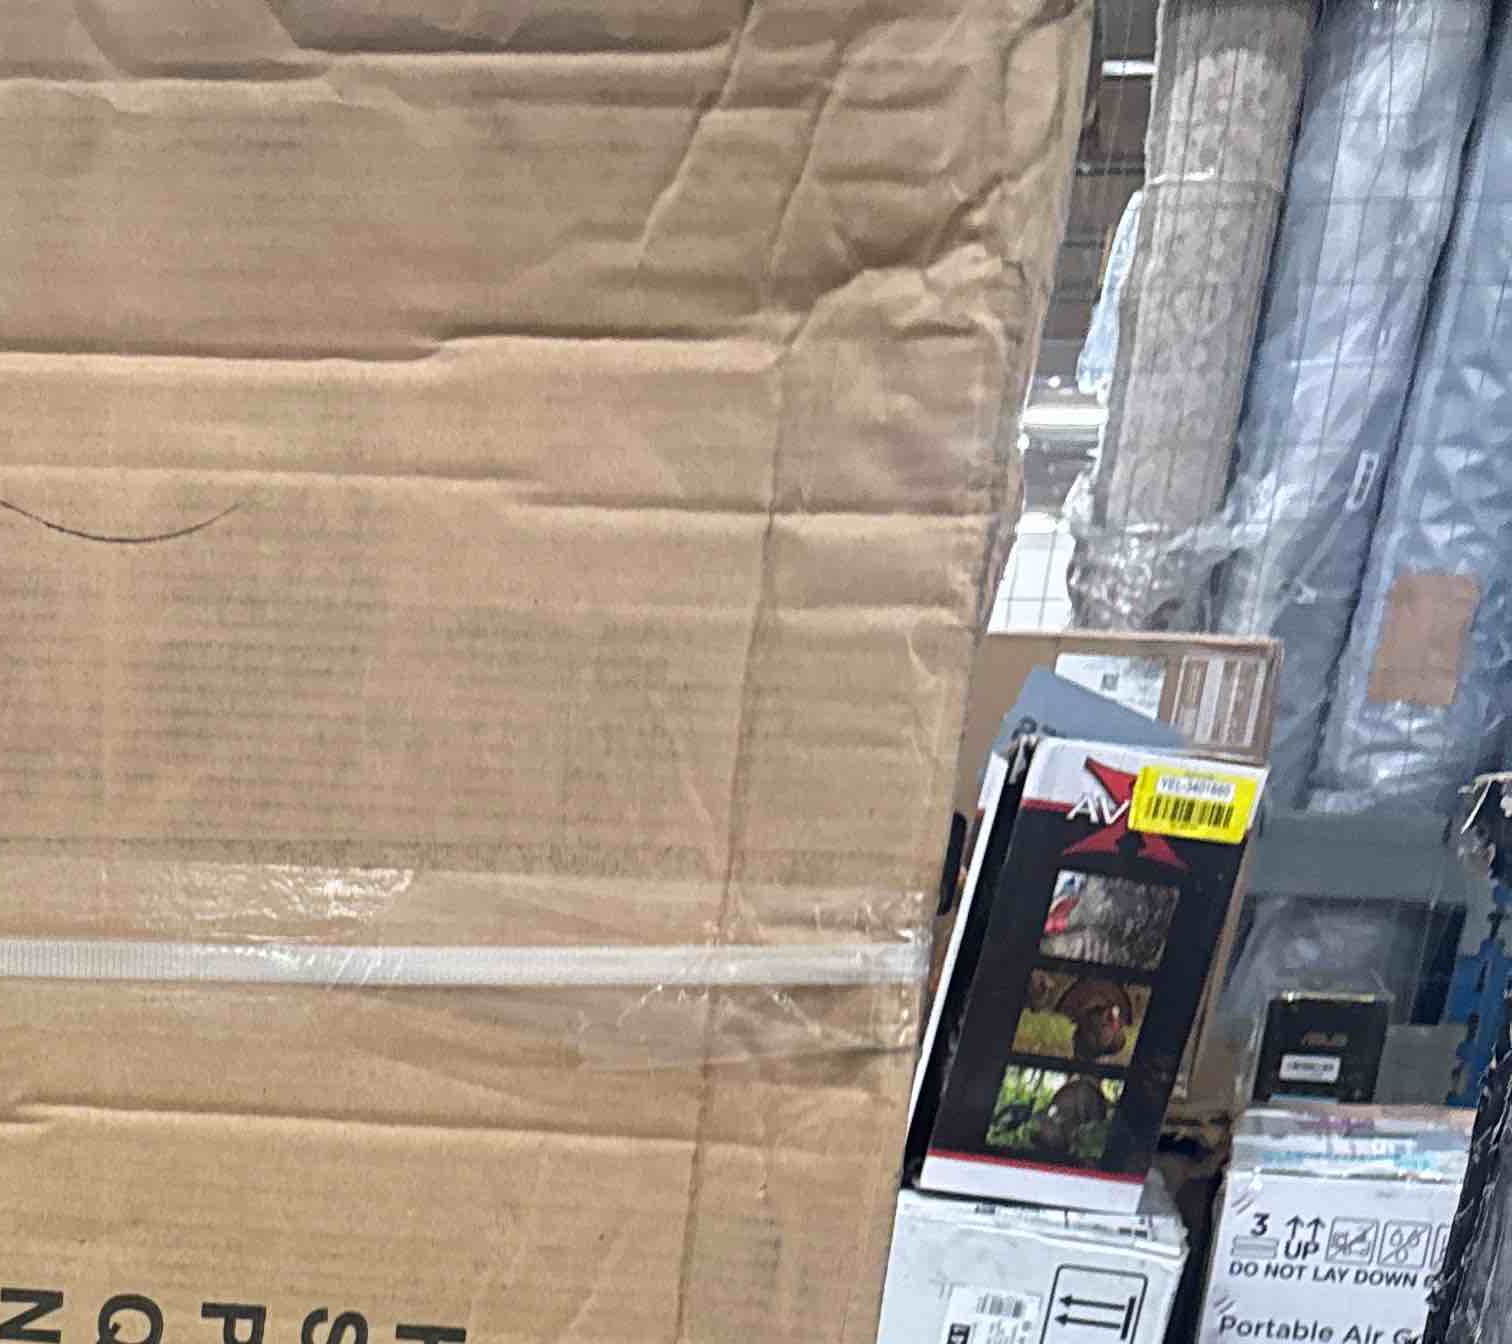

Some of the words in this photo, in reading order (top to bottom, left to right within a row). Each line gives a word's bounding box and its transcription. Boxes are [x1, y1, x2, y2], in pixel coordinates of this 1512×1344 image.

[1250, 1213, 1270, 1236] 3
[1284, 1240, 1320, 1260] UP
[1229, 1262, 1258, 1277] DO
[1264, 1263, 1307, 1281] NOT
[1312, 1266, 1350, 1283] LAY
[1354, 1269, 1418, 1288] DOWN
[1219, 1315, 1334, 1343] Portable
